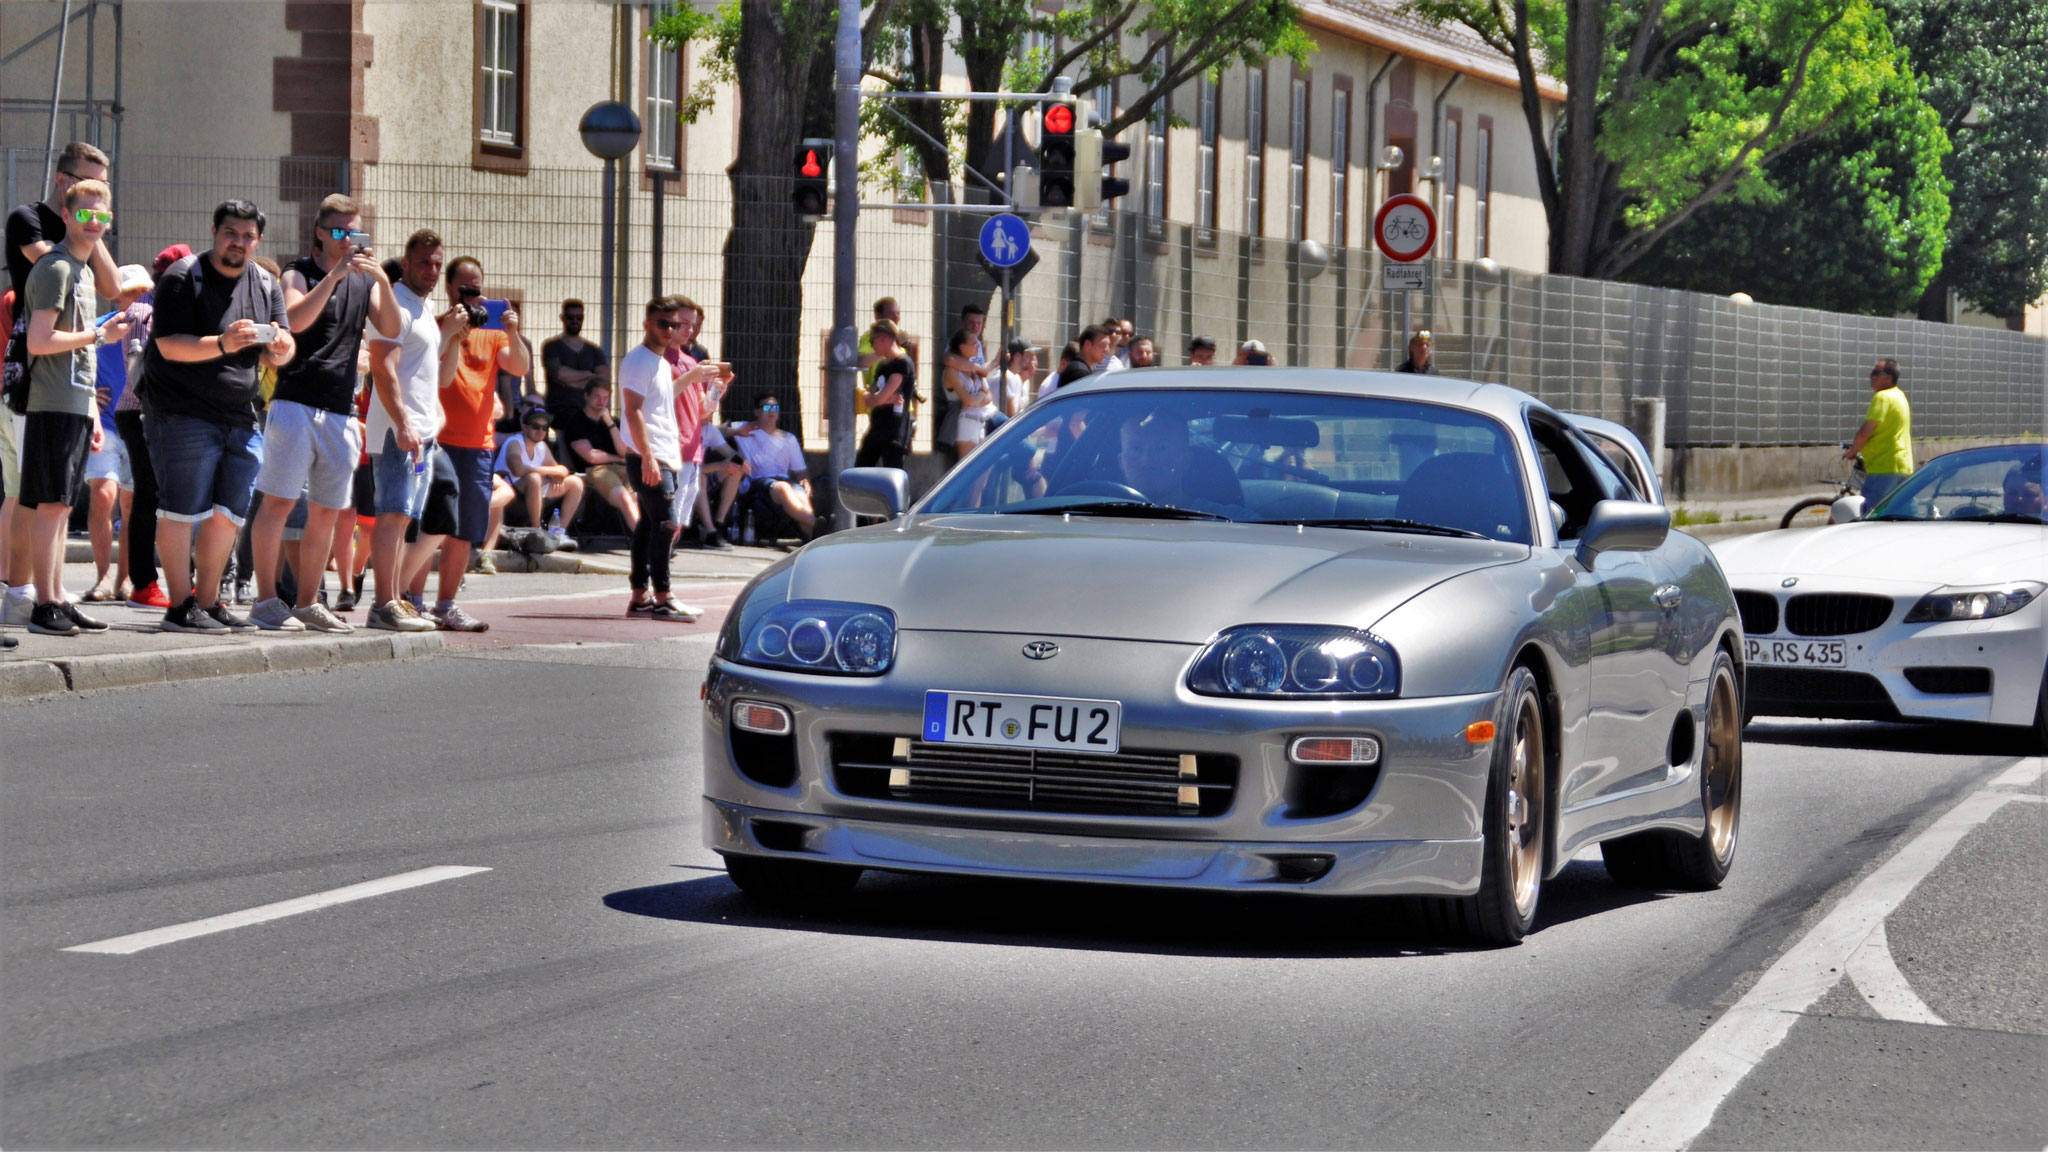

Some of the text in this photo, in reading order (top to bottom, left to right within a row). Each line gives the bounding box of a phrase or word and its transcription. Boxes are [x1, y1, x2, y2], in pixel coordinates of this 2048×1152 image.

[1386, 267, 1422, 279] Radfahrer
[1744, 640, 1843, 663] P RS 435
[931, 721, 940, 733] D
[952, 700, 1110, 745] RT FU 2
